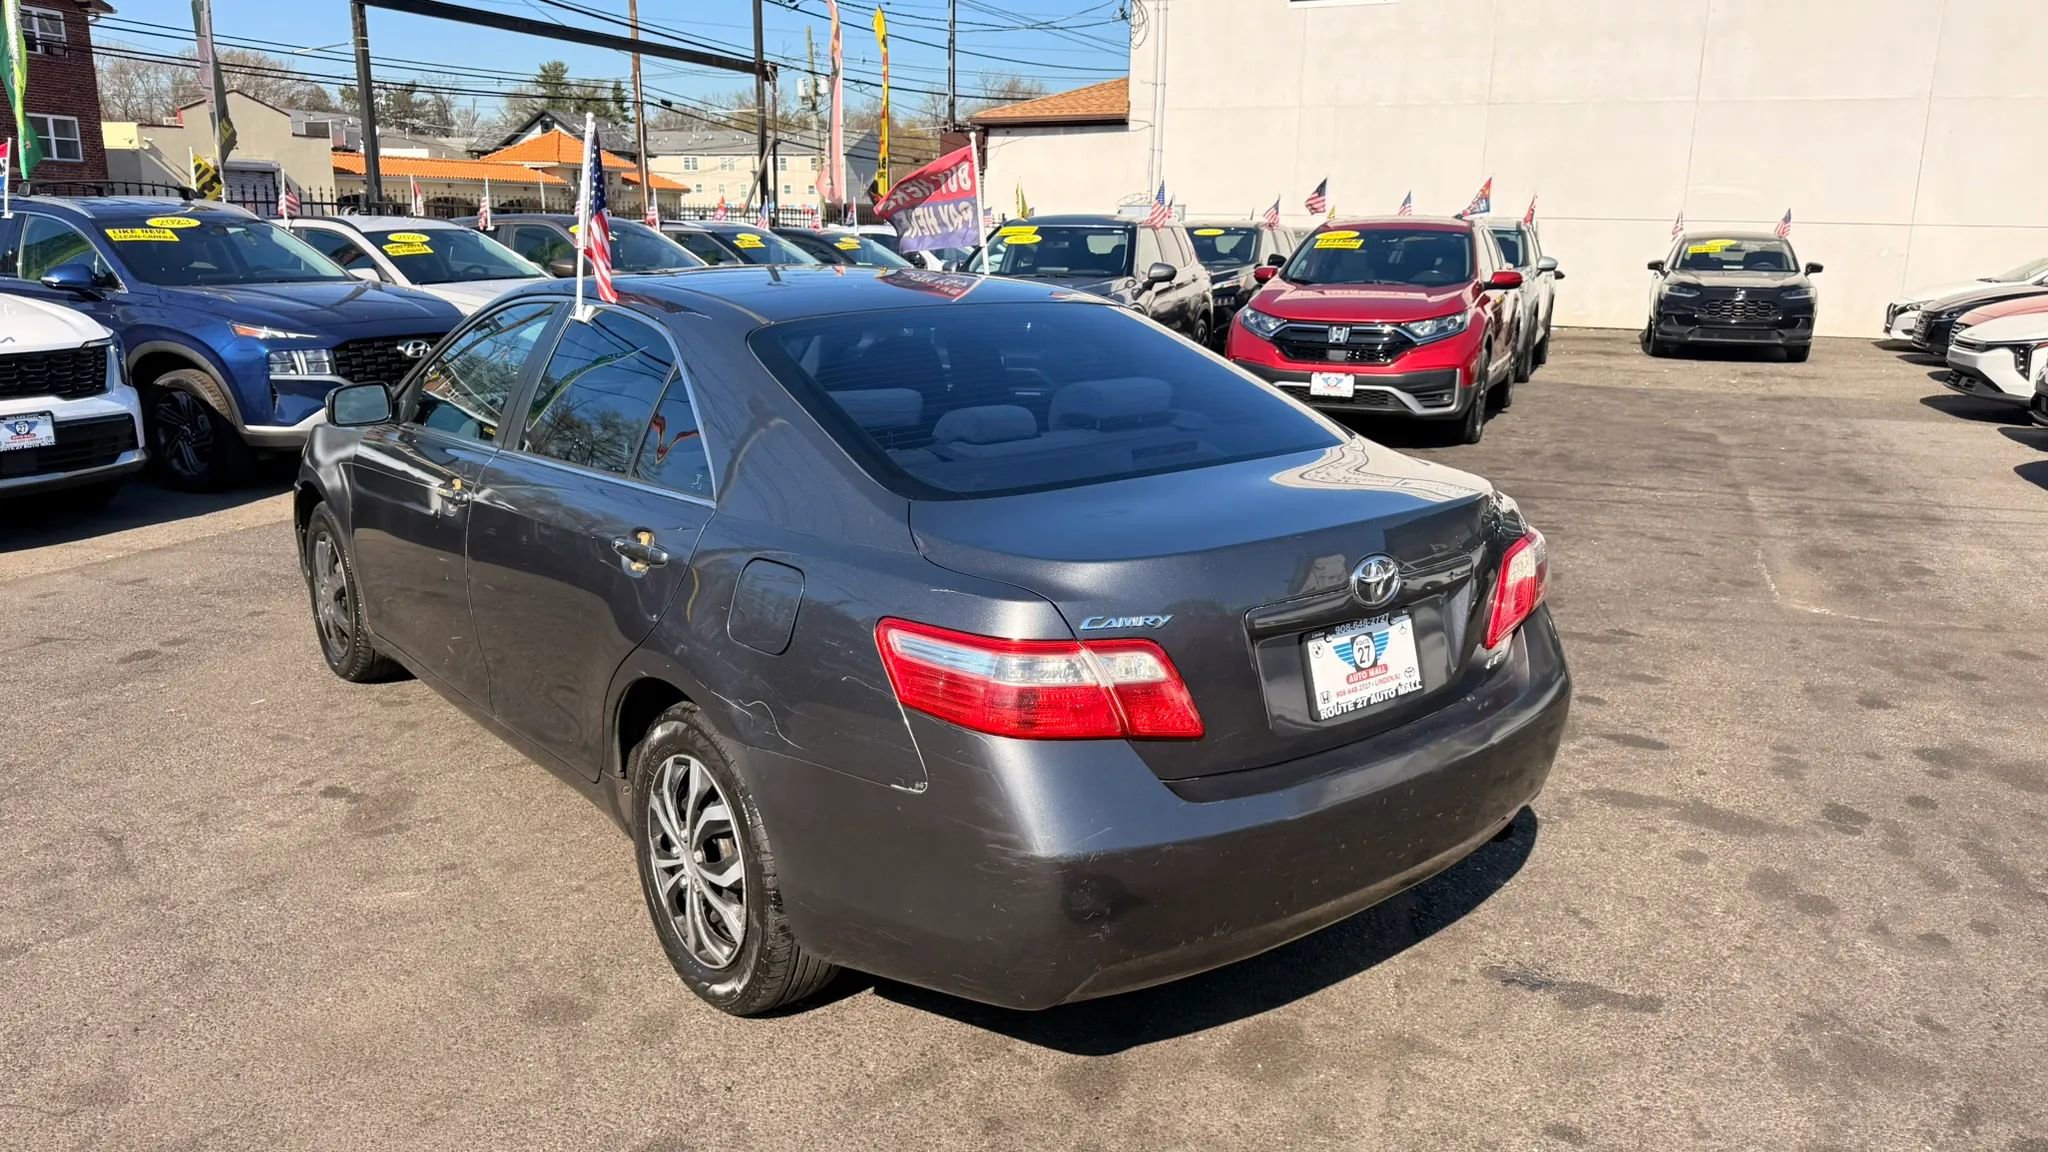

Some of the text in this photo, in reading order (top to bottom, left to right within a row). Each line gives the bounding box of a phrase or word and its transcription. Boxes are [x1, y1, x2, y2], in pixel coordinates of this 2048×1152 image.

[1080, 614, 1175, 631] CAMRY
[1334, 612, 1390, 635] 908-648-2727
[1357, 645, 1372, 665] 27
[1348, 665, 1387, 684] AUTO MALL
[1320, 679, 1423, 720] ROUTE 27 AUTO MALL
